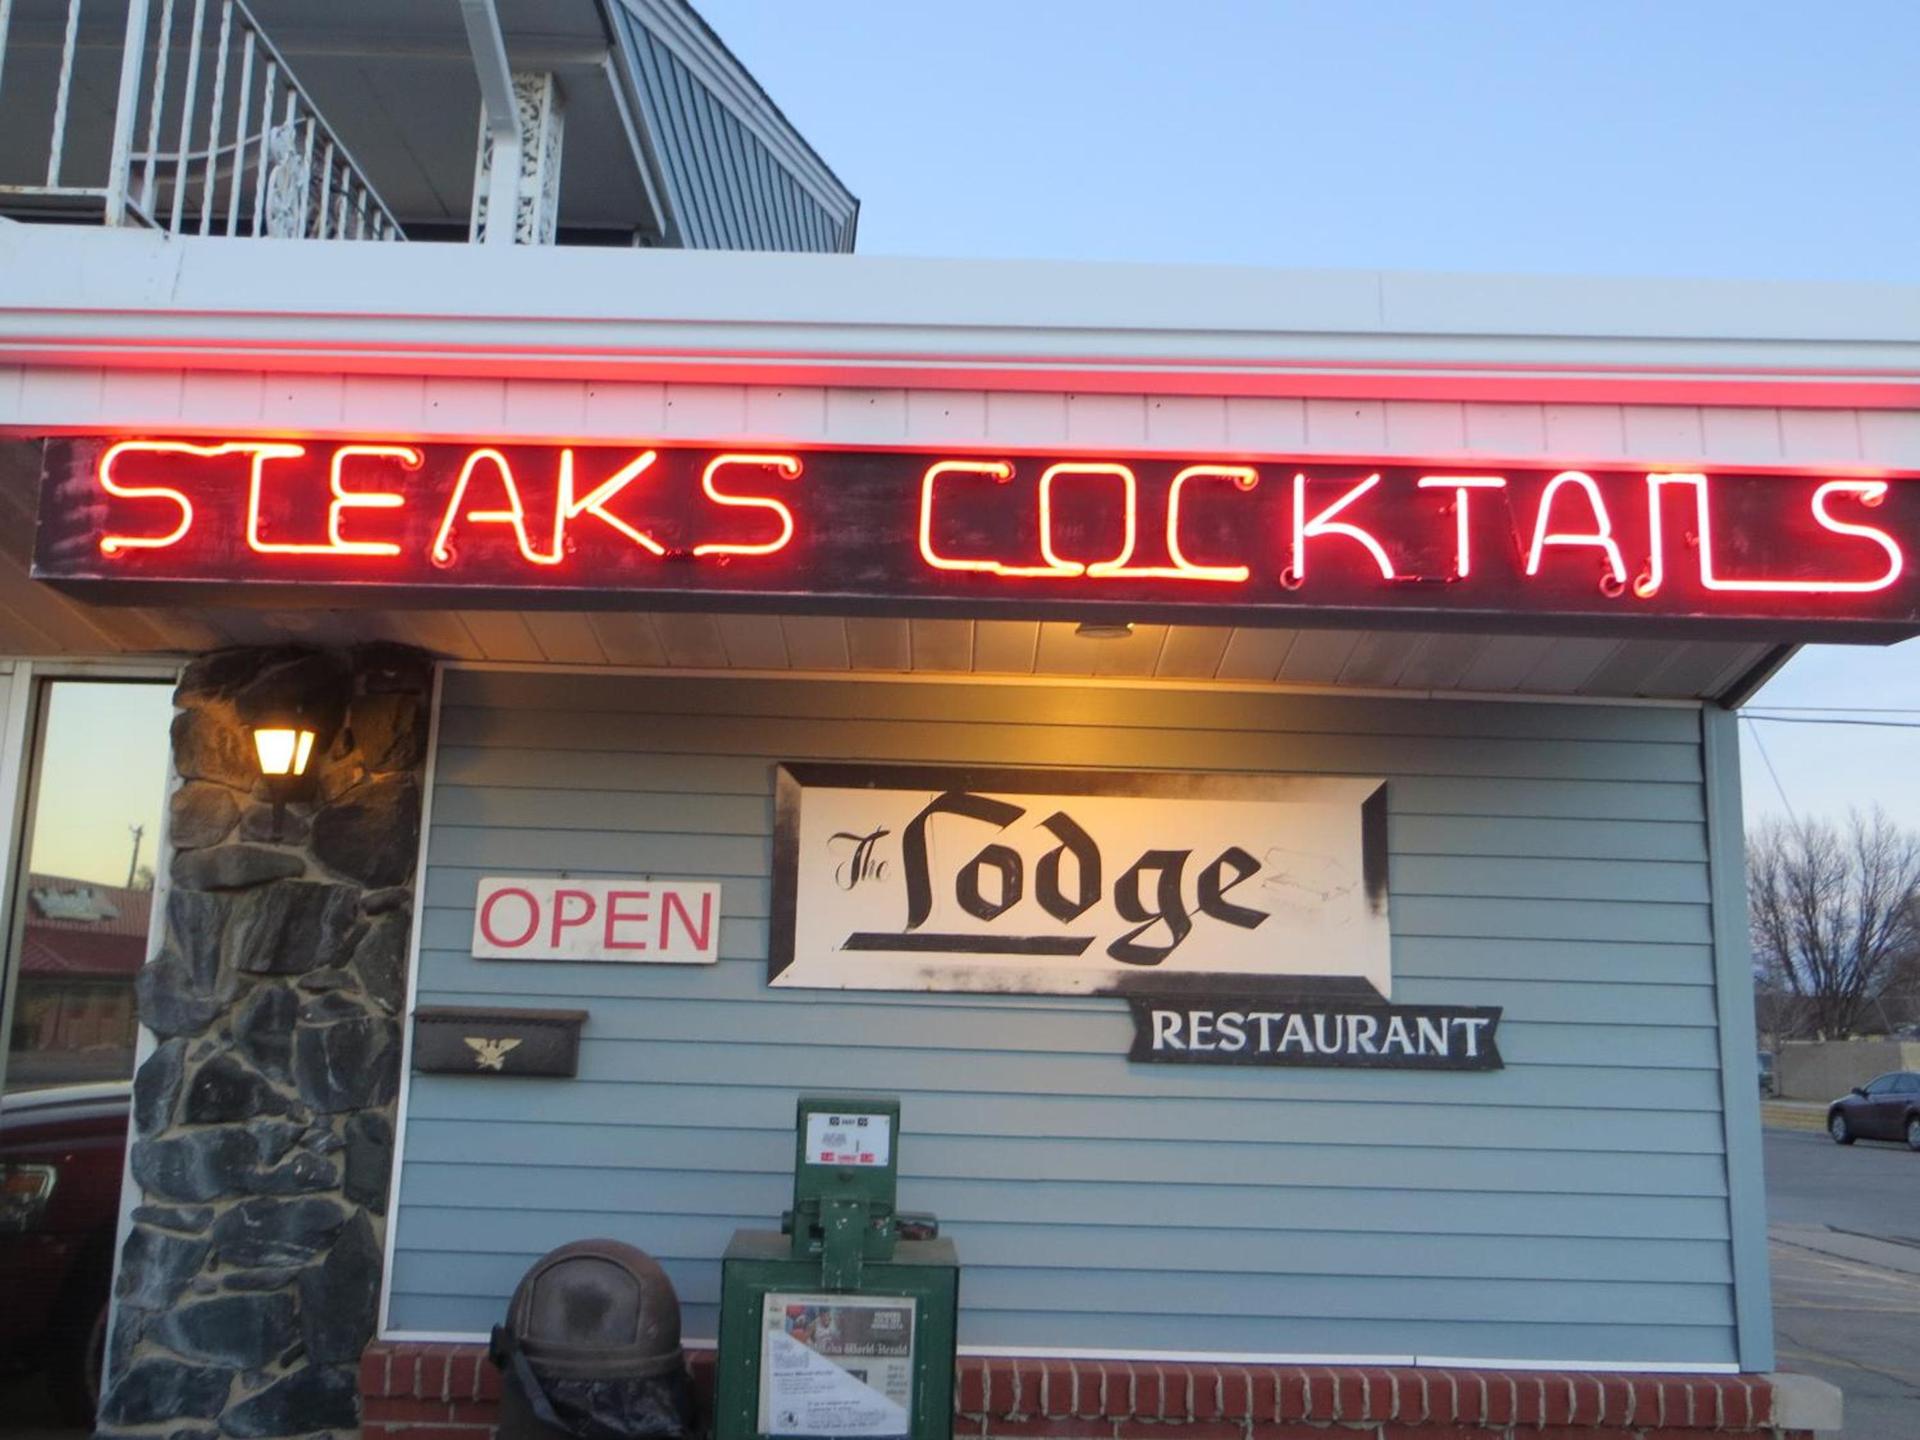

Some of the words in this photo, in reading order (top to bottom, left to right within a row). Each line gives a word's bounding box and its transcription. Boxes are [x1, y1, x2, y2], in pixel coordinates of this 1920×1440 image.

[99, 441, 802, 566] STEAKS
[918, 461, 1904, 597] COCKTAILS
[479, 887, 712, 951] OPEN
[828, 825, 891, 890] The
[902, 790, 1271, 967] Lodge
[1151, 1009, 1491, 1059] RESTAURANT
